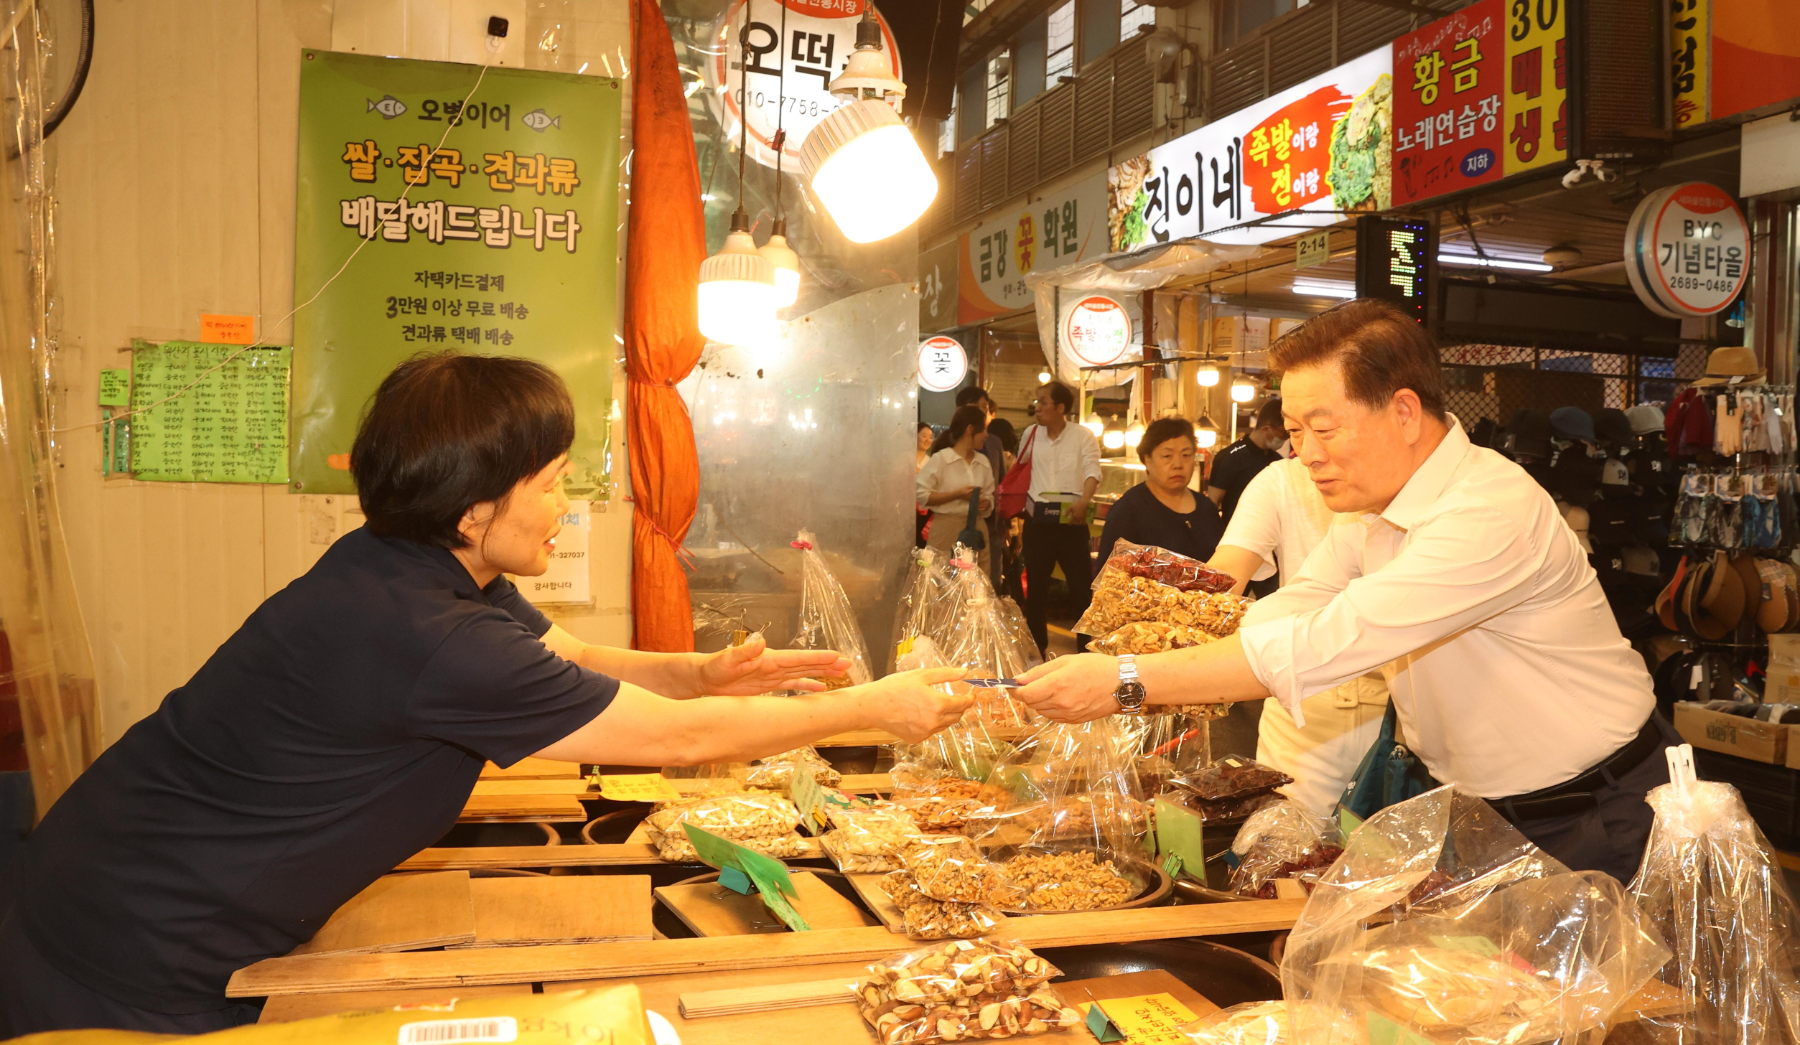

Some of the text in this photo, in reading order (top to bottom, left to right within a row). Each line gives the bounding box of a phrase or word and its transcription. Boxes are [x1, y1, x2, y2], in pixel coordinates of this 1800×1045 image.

[730, 21, 850, 91] 오떡
[1412, 36, 1483, 105] 황금
[417, 98, 511, 131] 오병이어
[1395, 94, 1502, 153] 노래연습장
[1248, 117, 1320, 168] 족발이랑
[1466, 153, 1489, 172] 지하
[1142, 136, 1242, 243] 진이네
[1270, 163, 1320, 207] 전이랑
[340, 195, 582, 254] 배달해드립니다
[1683, 219, 1723, 241] BYC
[979, 228, 1008, 283] 금강
[1018, 215, 1034, 271] 꽃
[1299, 235, 1326, 255] 2-14
[1660, 241, 1744, 279] 기념타올
[1670, 276, 1733, 293] 2689-0486
[386, 296, 530, 320] 3만원 이상 무료 배송
[401, 324, 515, 346] 견과류 택배 배송
[932, 352, 951, 374] 꽃
[534, 581, 573, 591] 감사합니다
